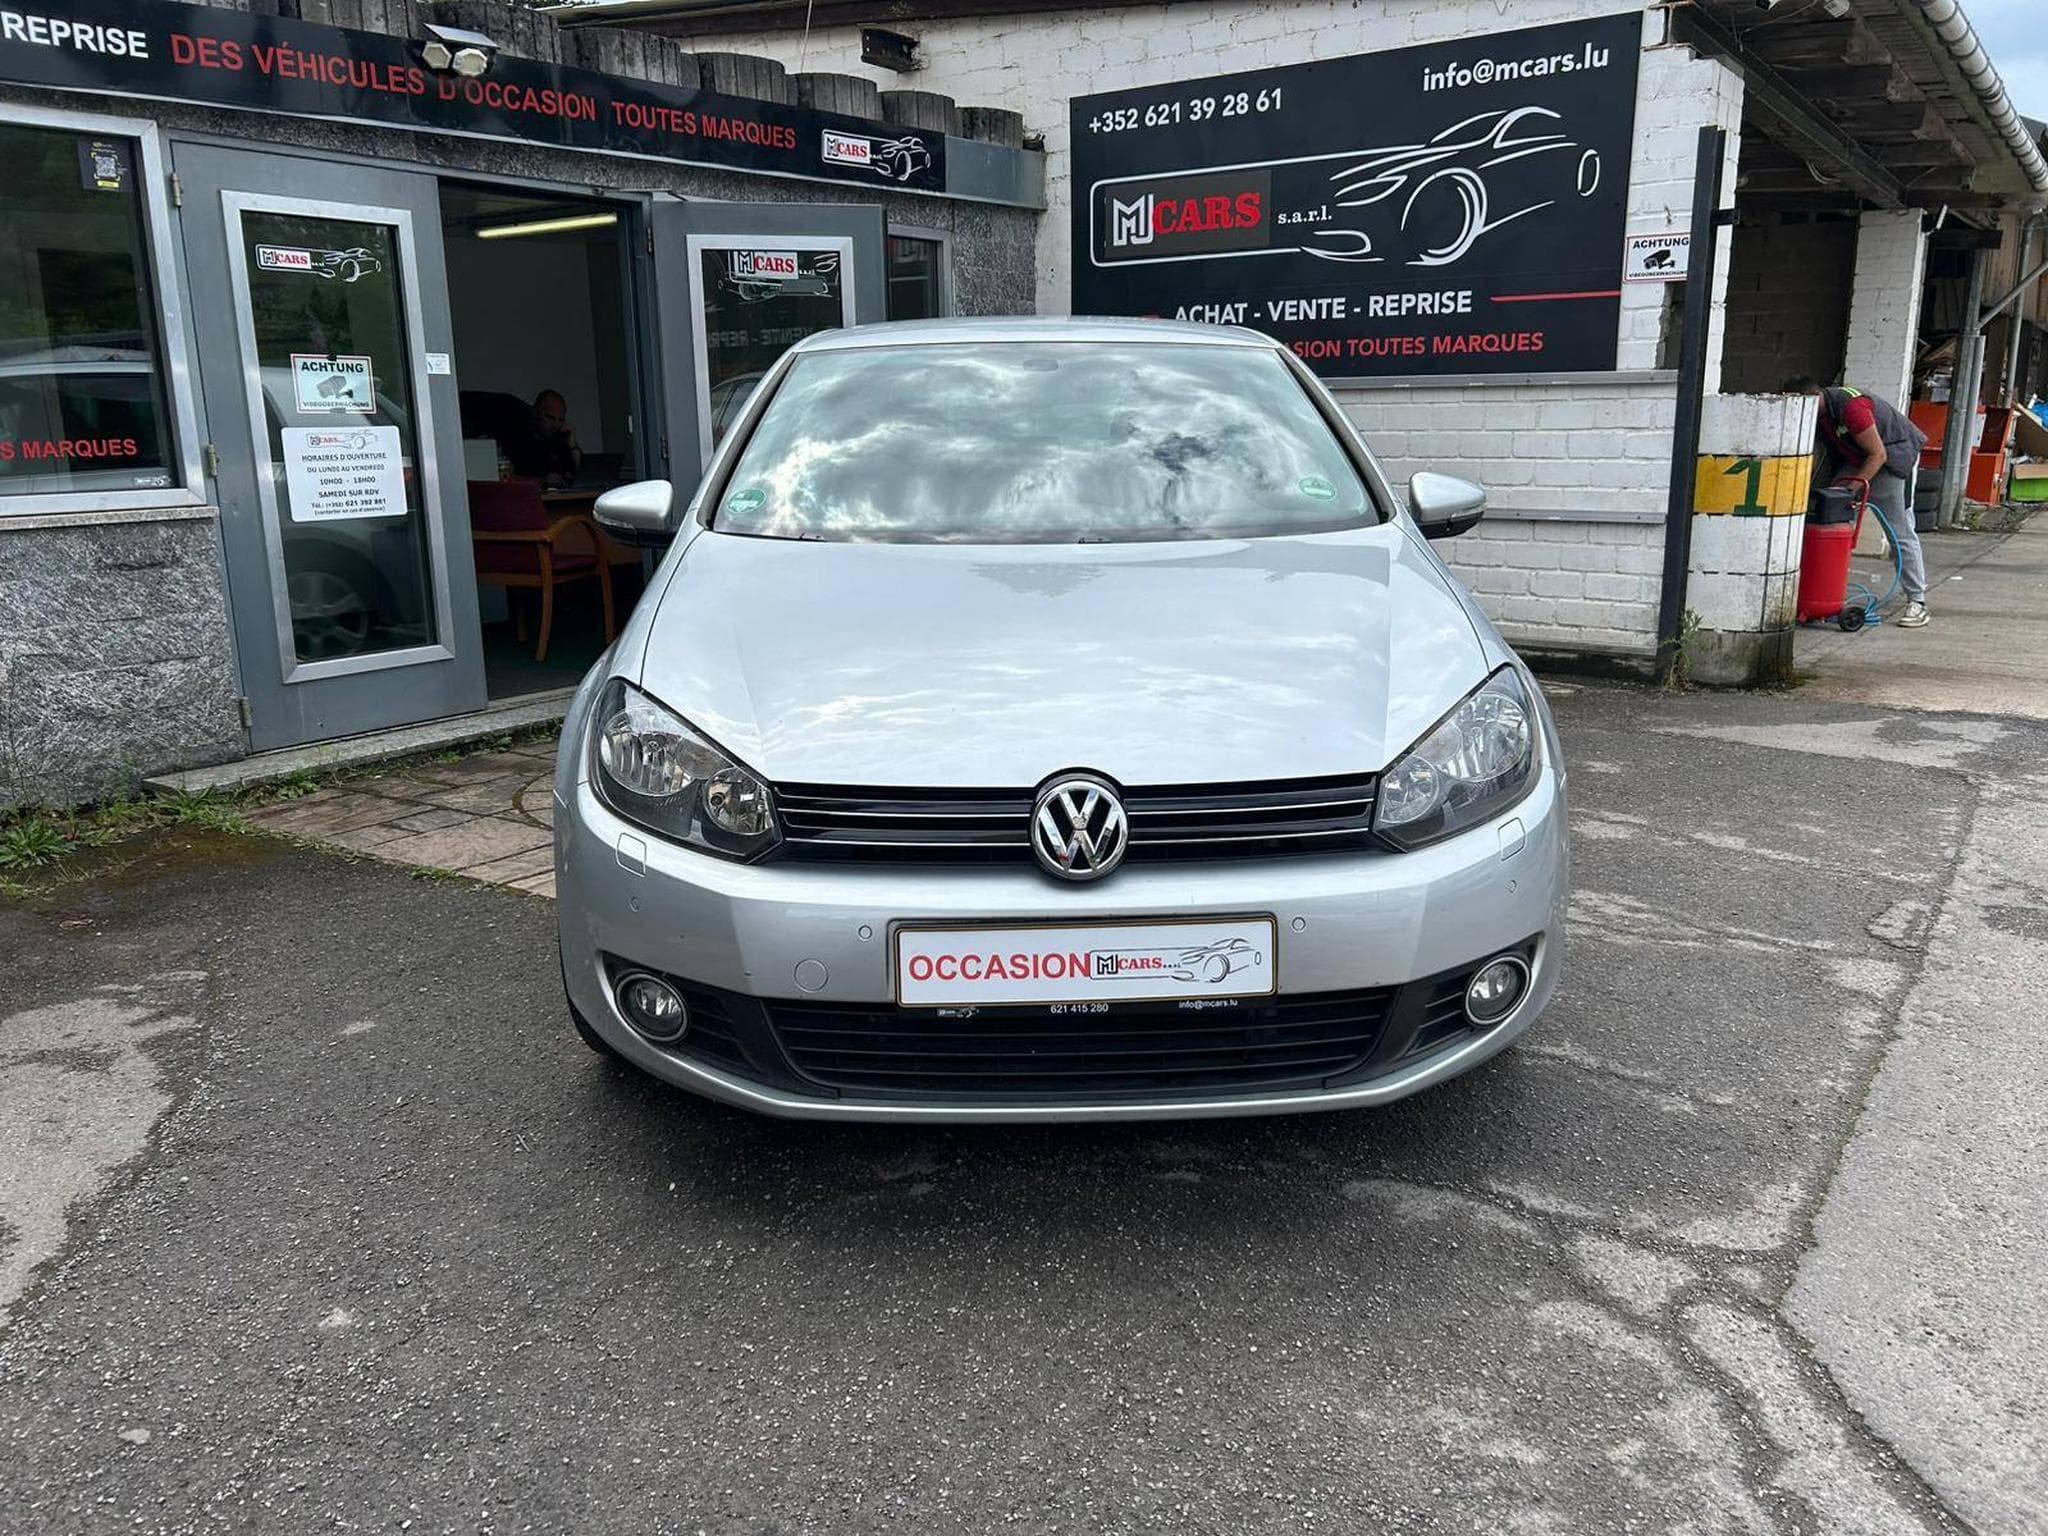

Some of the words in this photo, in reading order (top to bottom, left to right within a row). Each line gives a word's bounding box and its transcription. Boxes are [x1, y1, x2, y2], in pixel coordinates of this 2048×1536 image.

[1423, 42, 1609, 92] info@mcars.lu
[0, 11, 149, 58] REPRISE
[170, 34, 243, 71] DES
[251, 42, 427, 96] VÉHICULES
[611, 101, 697, 135] TOUTES
[702, 115, 797, 150] MARQUES
[1089, 108, 1139, 134] +352
[1145, 102, 1180, 126] 621
[1189, 97, 1215, 121] 39
[1222, 92, 1249, 116] 28
[1256, 87, 1281, 112] 61
[1278, 205, 1332, 225] s.a.r.l.
[1633, 237, 1689, 249] ACHTUNG
[1175, 303, 1248, 325] ACHAT
[1268, 298, 1346, 322] VENTE
[1369, 290, 1472, 317] REPRISE
[1347, 337, 1426, 357] TOUTES
[1432, 332, 1545, 354] MARQUES
[301, 362, 364, 373] ACHTUNG
[22, 439, 138, 460] MARQUES
[1724, 459, 1767, 515] 1
[908, 953, 1090, 981] OCCASION
[1050, 1005, 1067, 1014] 621
[1070, 1004, 1088, 1013] 415
